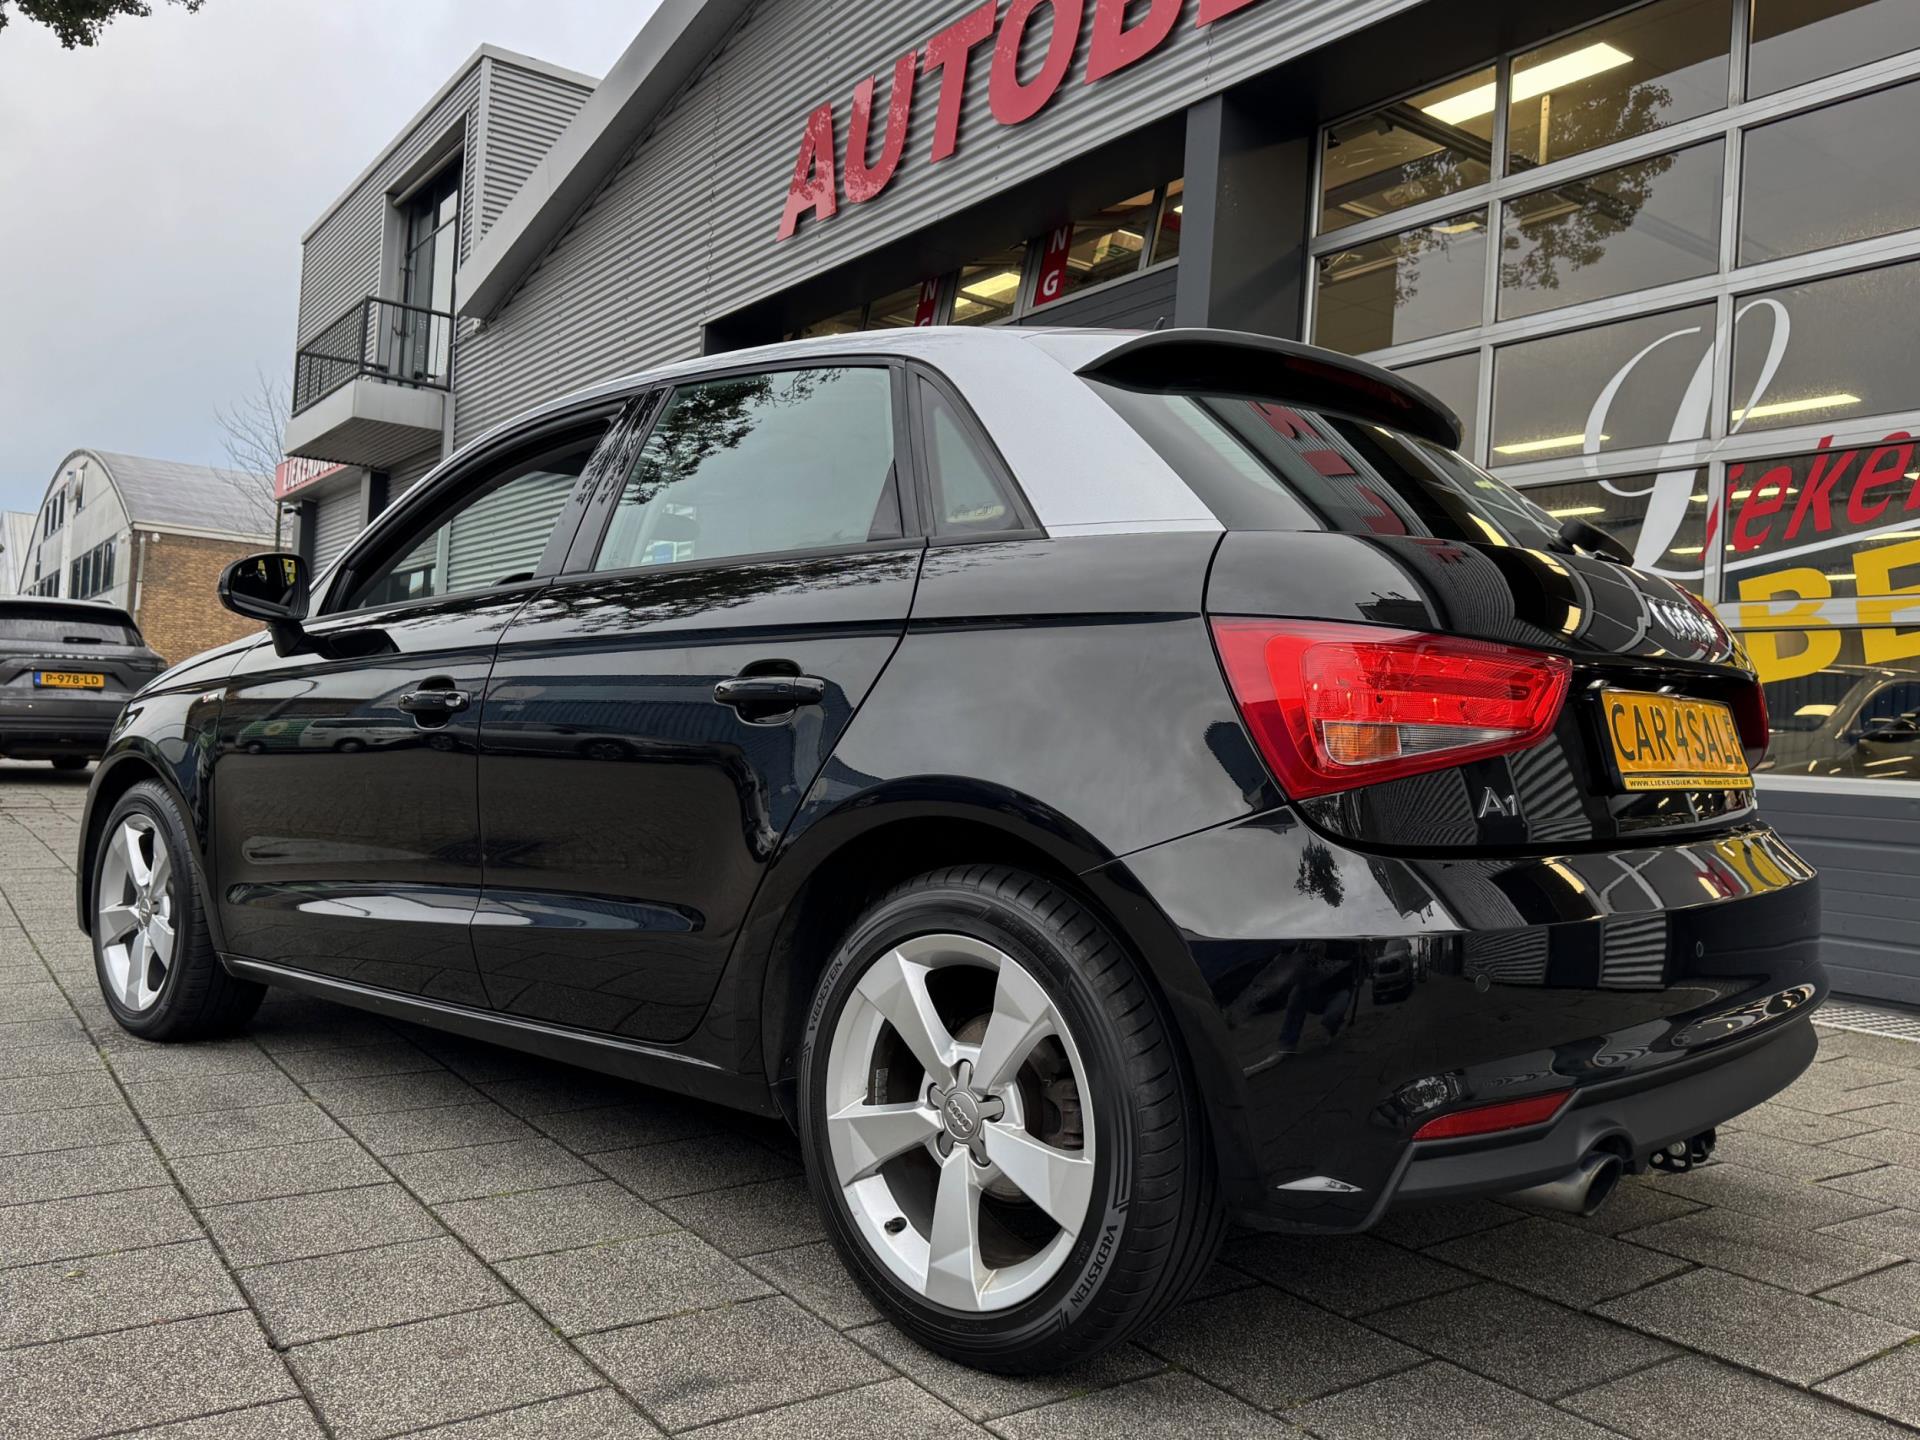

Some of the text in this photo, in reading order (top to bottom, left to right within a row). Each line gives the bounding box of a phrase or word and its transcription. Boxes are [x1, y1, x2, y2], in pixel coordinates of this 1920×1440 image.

[776, 0, 1254, 242] AUTOB
[45, 673, 99, 685] P-978-LD
[1611, 703, 1743, 765] CAR4SALE
[1478, 786, 1518, 818] A1
[808, 958, 843, 1031] VREDESTEIN
[1069, 1225, 1118, 1309] VREDESTEIN
